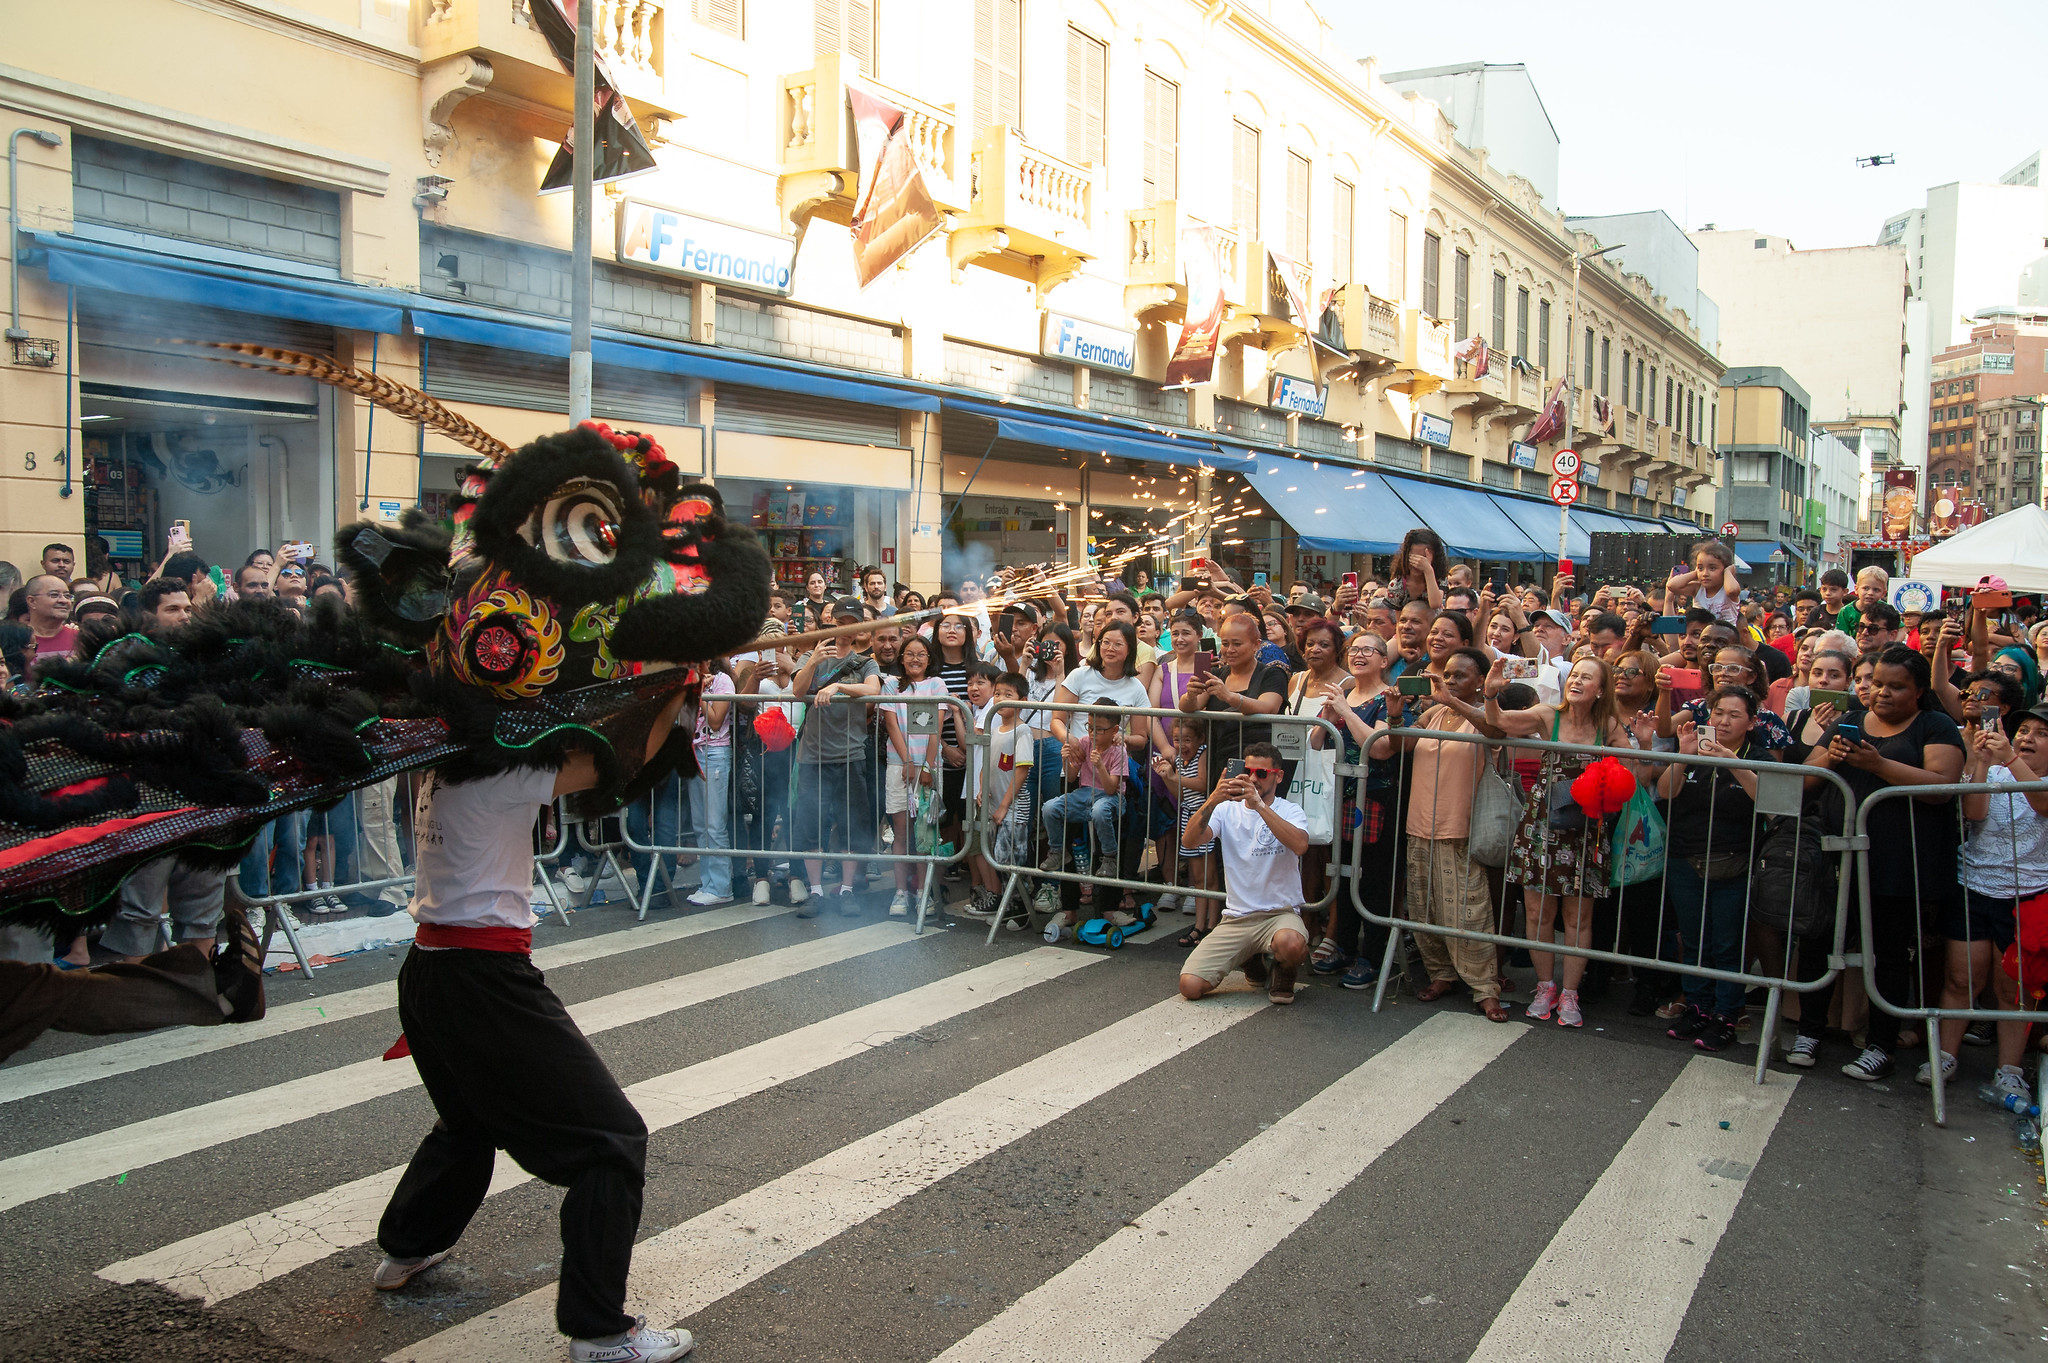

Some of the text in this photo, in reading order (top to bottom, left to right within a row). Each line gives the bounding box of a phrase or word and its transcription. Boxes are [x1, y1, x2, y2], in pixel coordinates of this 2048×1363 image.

[681, 238, 790, 288] Fernando
[1074, 335, 1132, 369] Fernando
[1289, 391, 1324, 415] Fernando
[1426, 426, 1449, 446] Fernando
[1557, 455, 1576, 468] 40
[109, 470, 123, 480] 03
[984, 503, 1009, 515] Entrada
